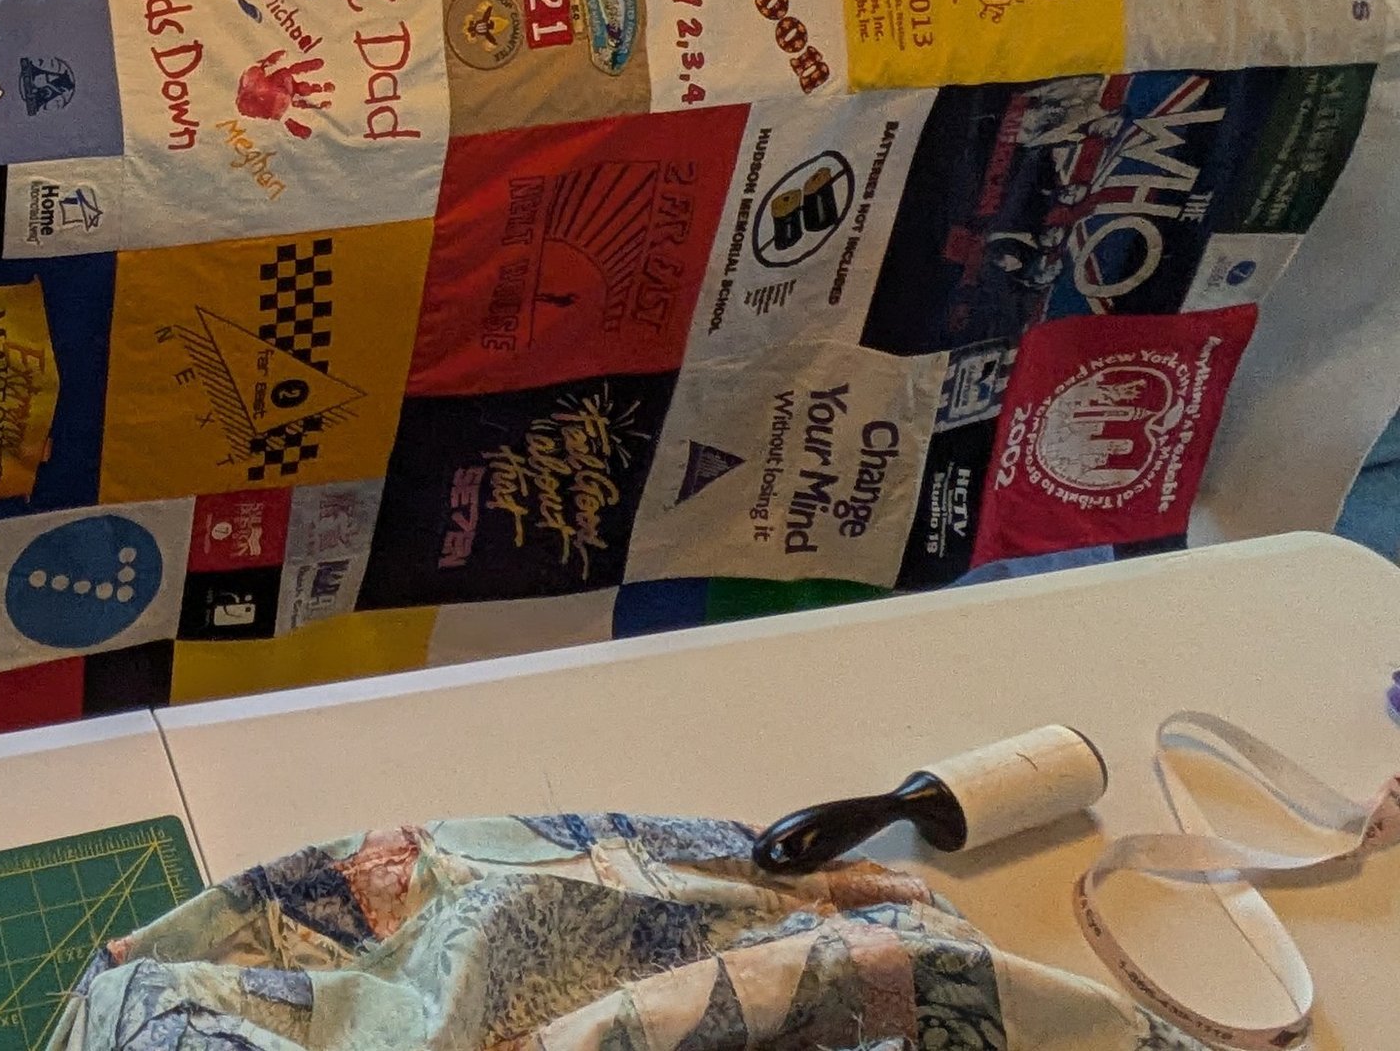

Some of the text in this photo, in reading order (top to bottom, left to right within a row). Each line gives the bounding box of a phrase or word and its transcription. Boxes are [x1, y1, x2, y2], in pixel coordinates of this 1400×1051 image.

[353, 20, 422, 141] Dad
[872, 15, 887, 42] Inc.
[149, 39, 205, 152] Down
[41, 184, 60, 236] Home
[216, 117, 288, 202] Meghan
[828, 120, 901, 308] BATTERIES NOT INCLUDED
[1072, 107, 1227, 298] WHO
[707, 128, 773, 337] HUDSON MEMORIAL SCHOOL
[524, 432, 577, 565] about
[748, 389, 796, 543] Without losing it
[784, 382, 851, 556] Your Mind
[833, 420, 900, 539] Change
[927, 471, 946, 529] Studio
[953, 467, 972, 538] HCTV
[993, 402, 1033, 491] 2002
